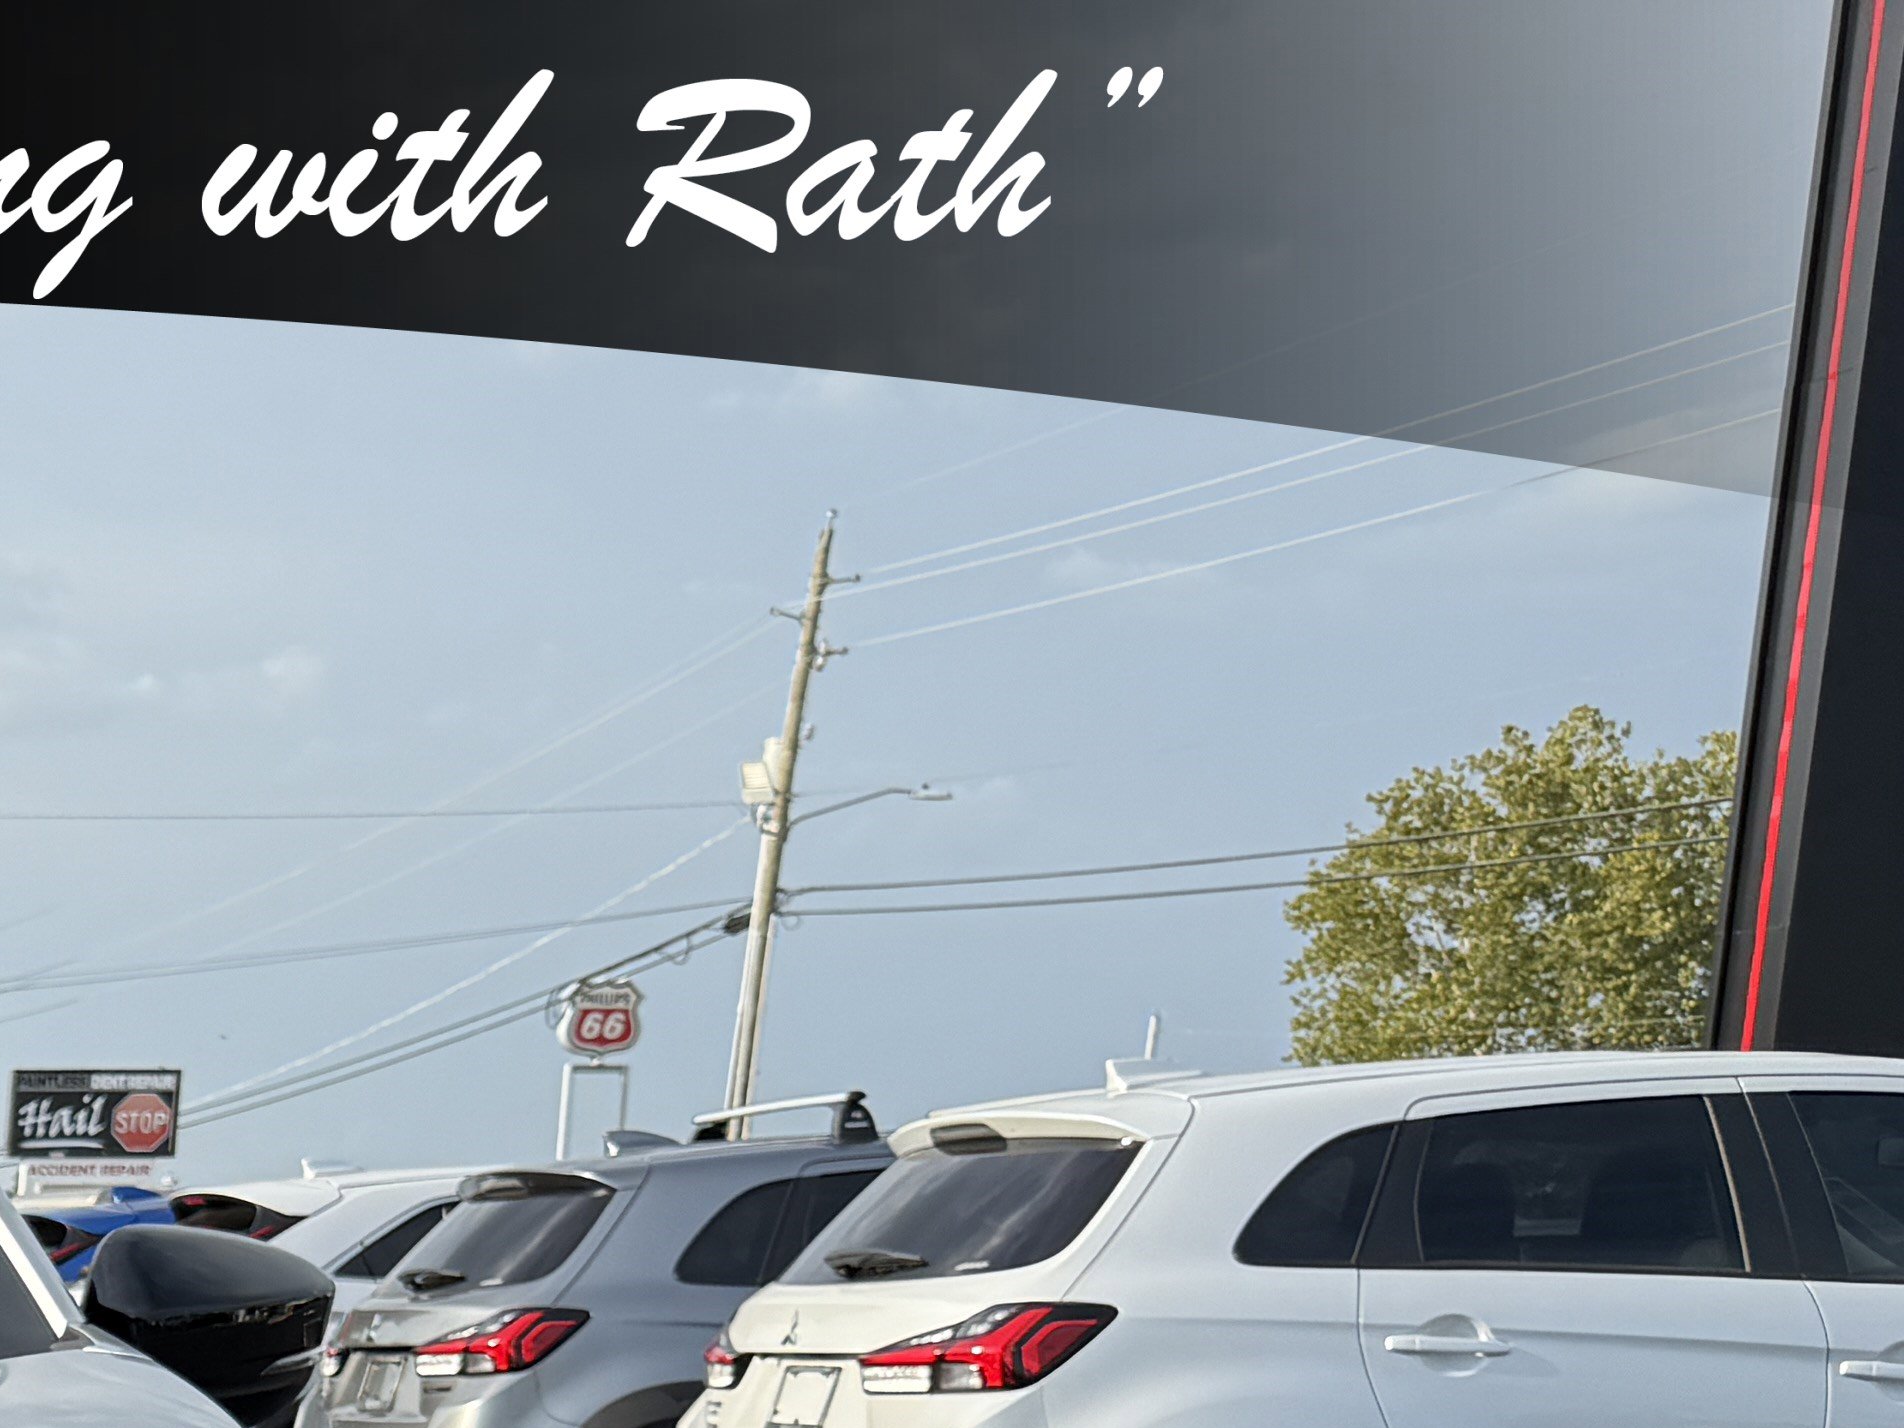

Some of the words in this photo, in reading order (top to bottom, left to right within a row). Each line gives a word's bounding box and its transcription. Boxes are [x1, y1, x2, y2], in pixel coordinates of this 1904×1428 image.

[580, 1010, 626, 1040] 66
[17, 1094, 108, 1138] Hail
[114, 1110, 168, 1135] STOP
